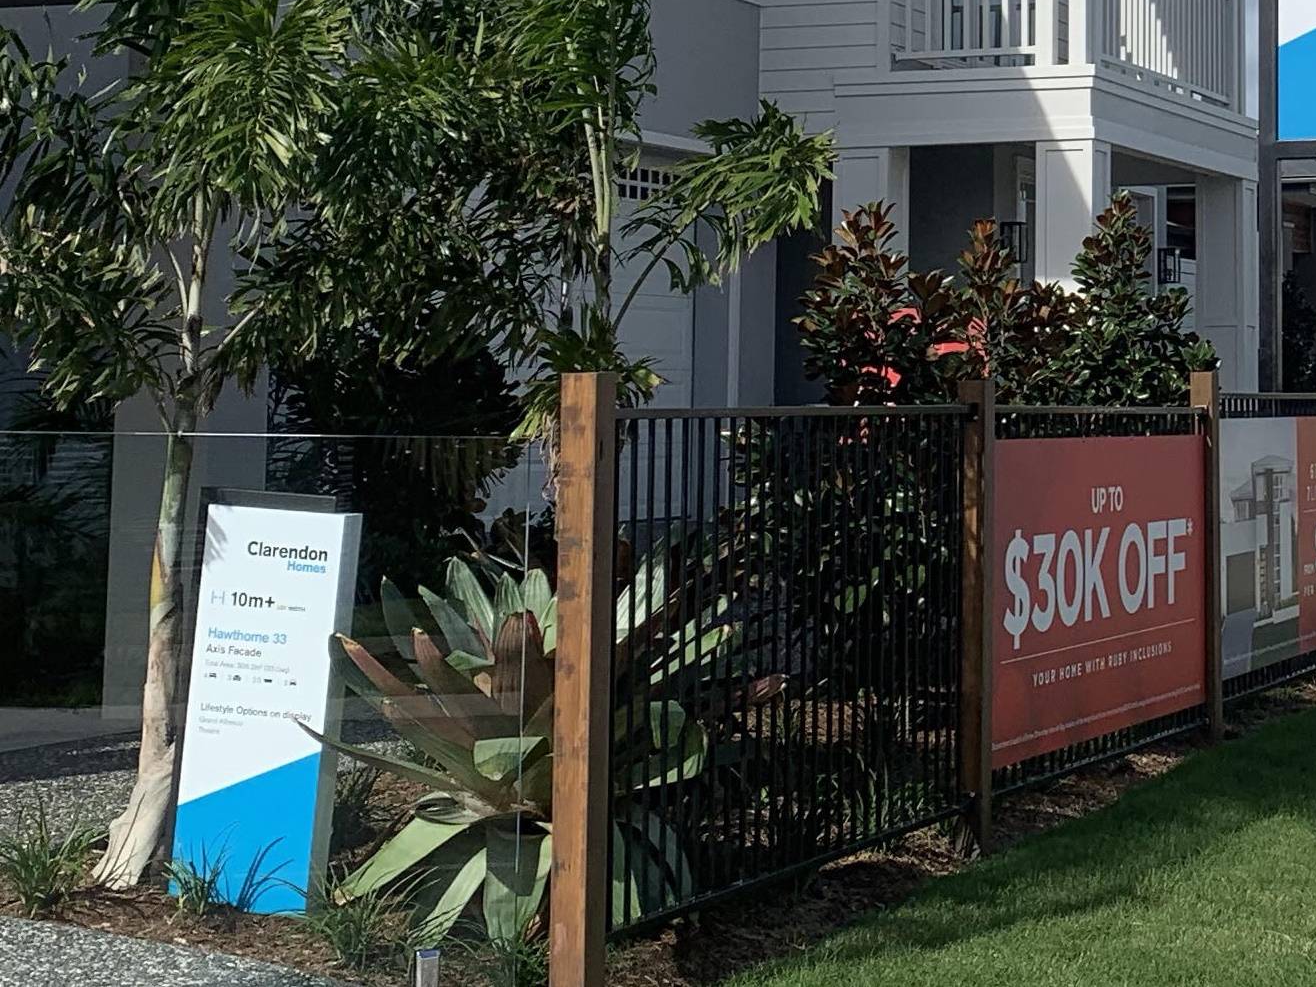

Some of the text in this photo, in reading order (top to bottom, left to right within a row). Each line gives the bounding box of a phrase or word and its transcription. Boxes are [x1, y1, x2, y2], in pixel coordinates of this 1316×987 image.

[1091, 485, 1124, 514] UP TO
[247, 540, 328, 562] Clarendon
[287, 560, 327, 573] Homes
[1003, 527, 1111, 650] $30K
[231, 591, 275, 609] 10m+
[208, 627, 288, 645] Hawthorne 33
[206, 644, 262, 658] Axis Facade
[1032, 640, 1172, 688] YOUR HOME WITH RUBY INCLUSIONS
[200, 702, 233, 714] Lifestyle
[236, 705, 268, 717] Options
